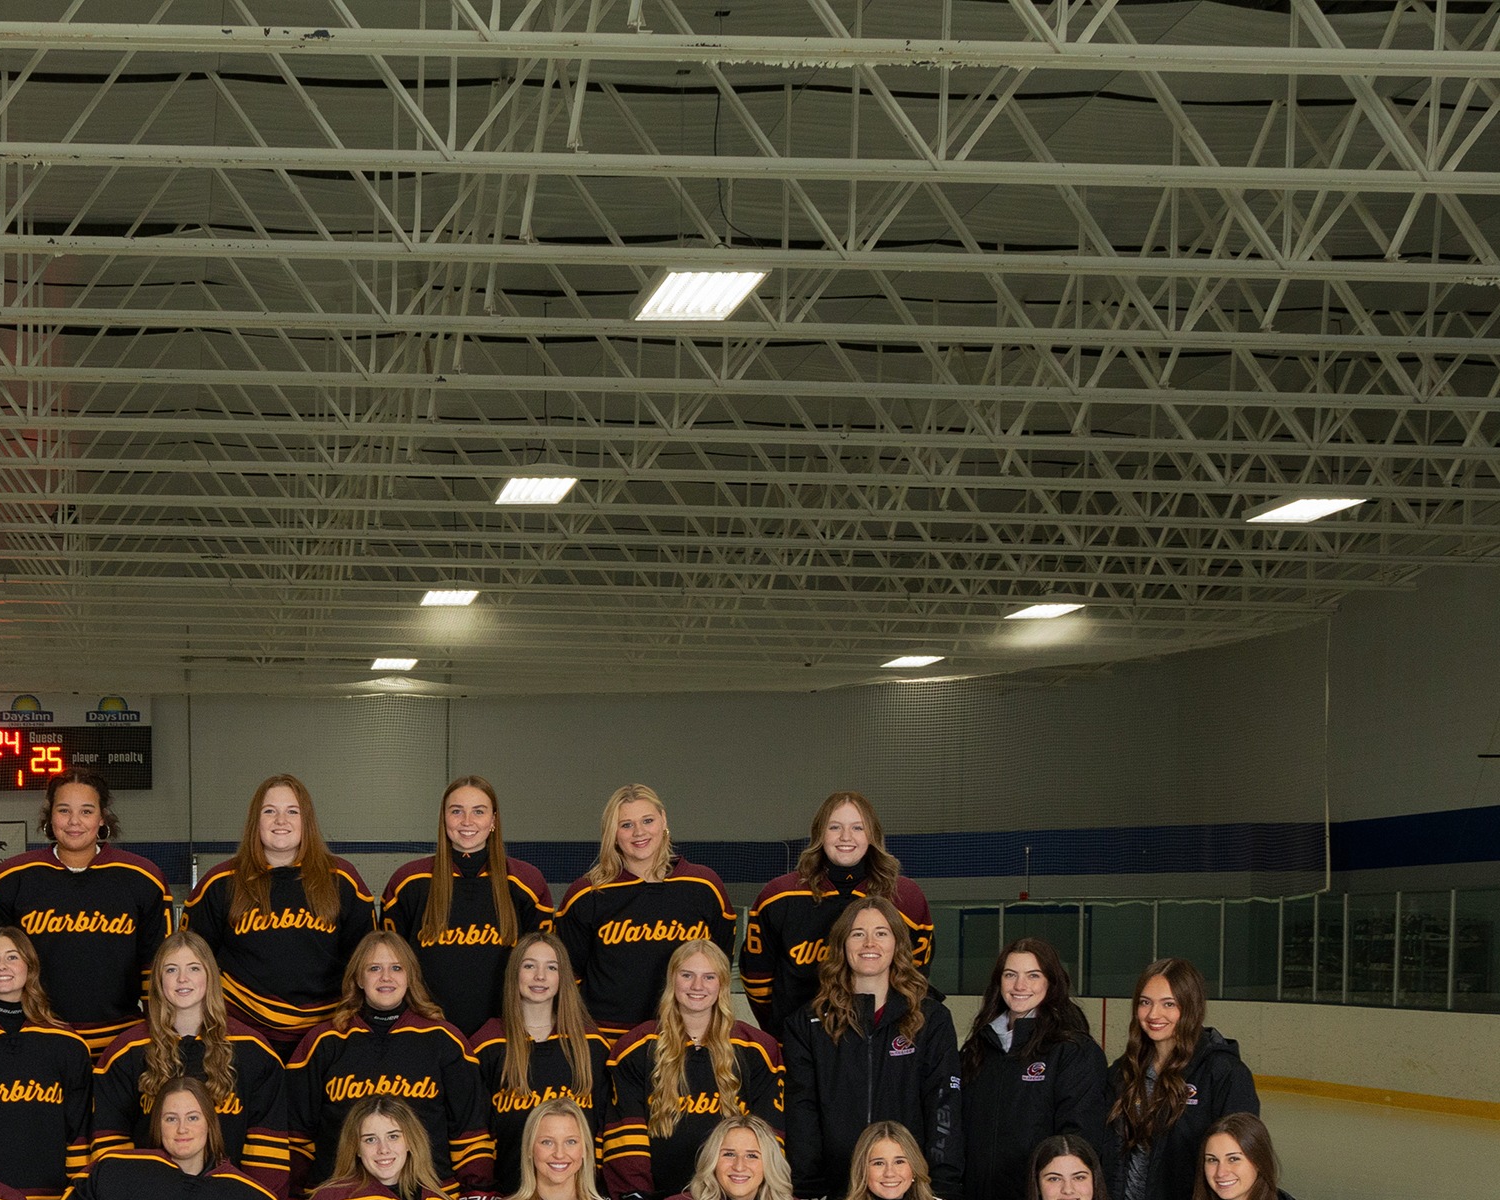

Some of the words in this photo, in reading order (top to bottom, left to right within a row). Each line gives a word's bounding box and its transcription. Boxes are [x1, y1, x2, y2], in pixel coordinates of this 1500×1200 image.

[2, 711, 31, 722] Days
[32, 711, 51, 720] Inn
[89, 711, 118, 722] Days
[119, 711, 138, 720] Inn
[29, 731, 63, 744] Guests
[31, 746, 63, 773] 25
[71, 752, 99, 765] player
[108, 751, 143, 765] penalty
[17, 769, 24, 787] 1
[21, 909, 136, 936] Warbirds
[598, 918, 712, 946] Warbirds
[325, 1074, 440, 1102] Warbirds
